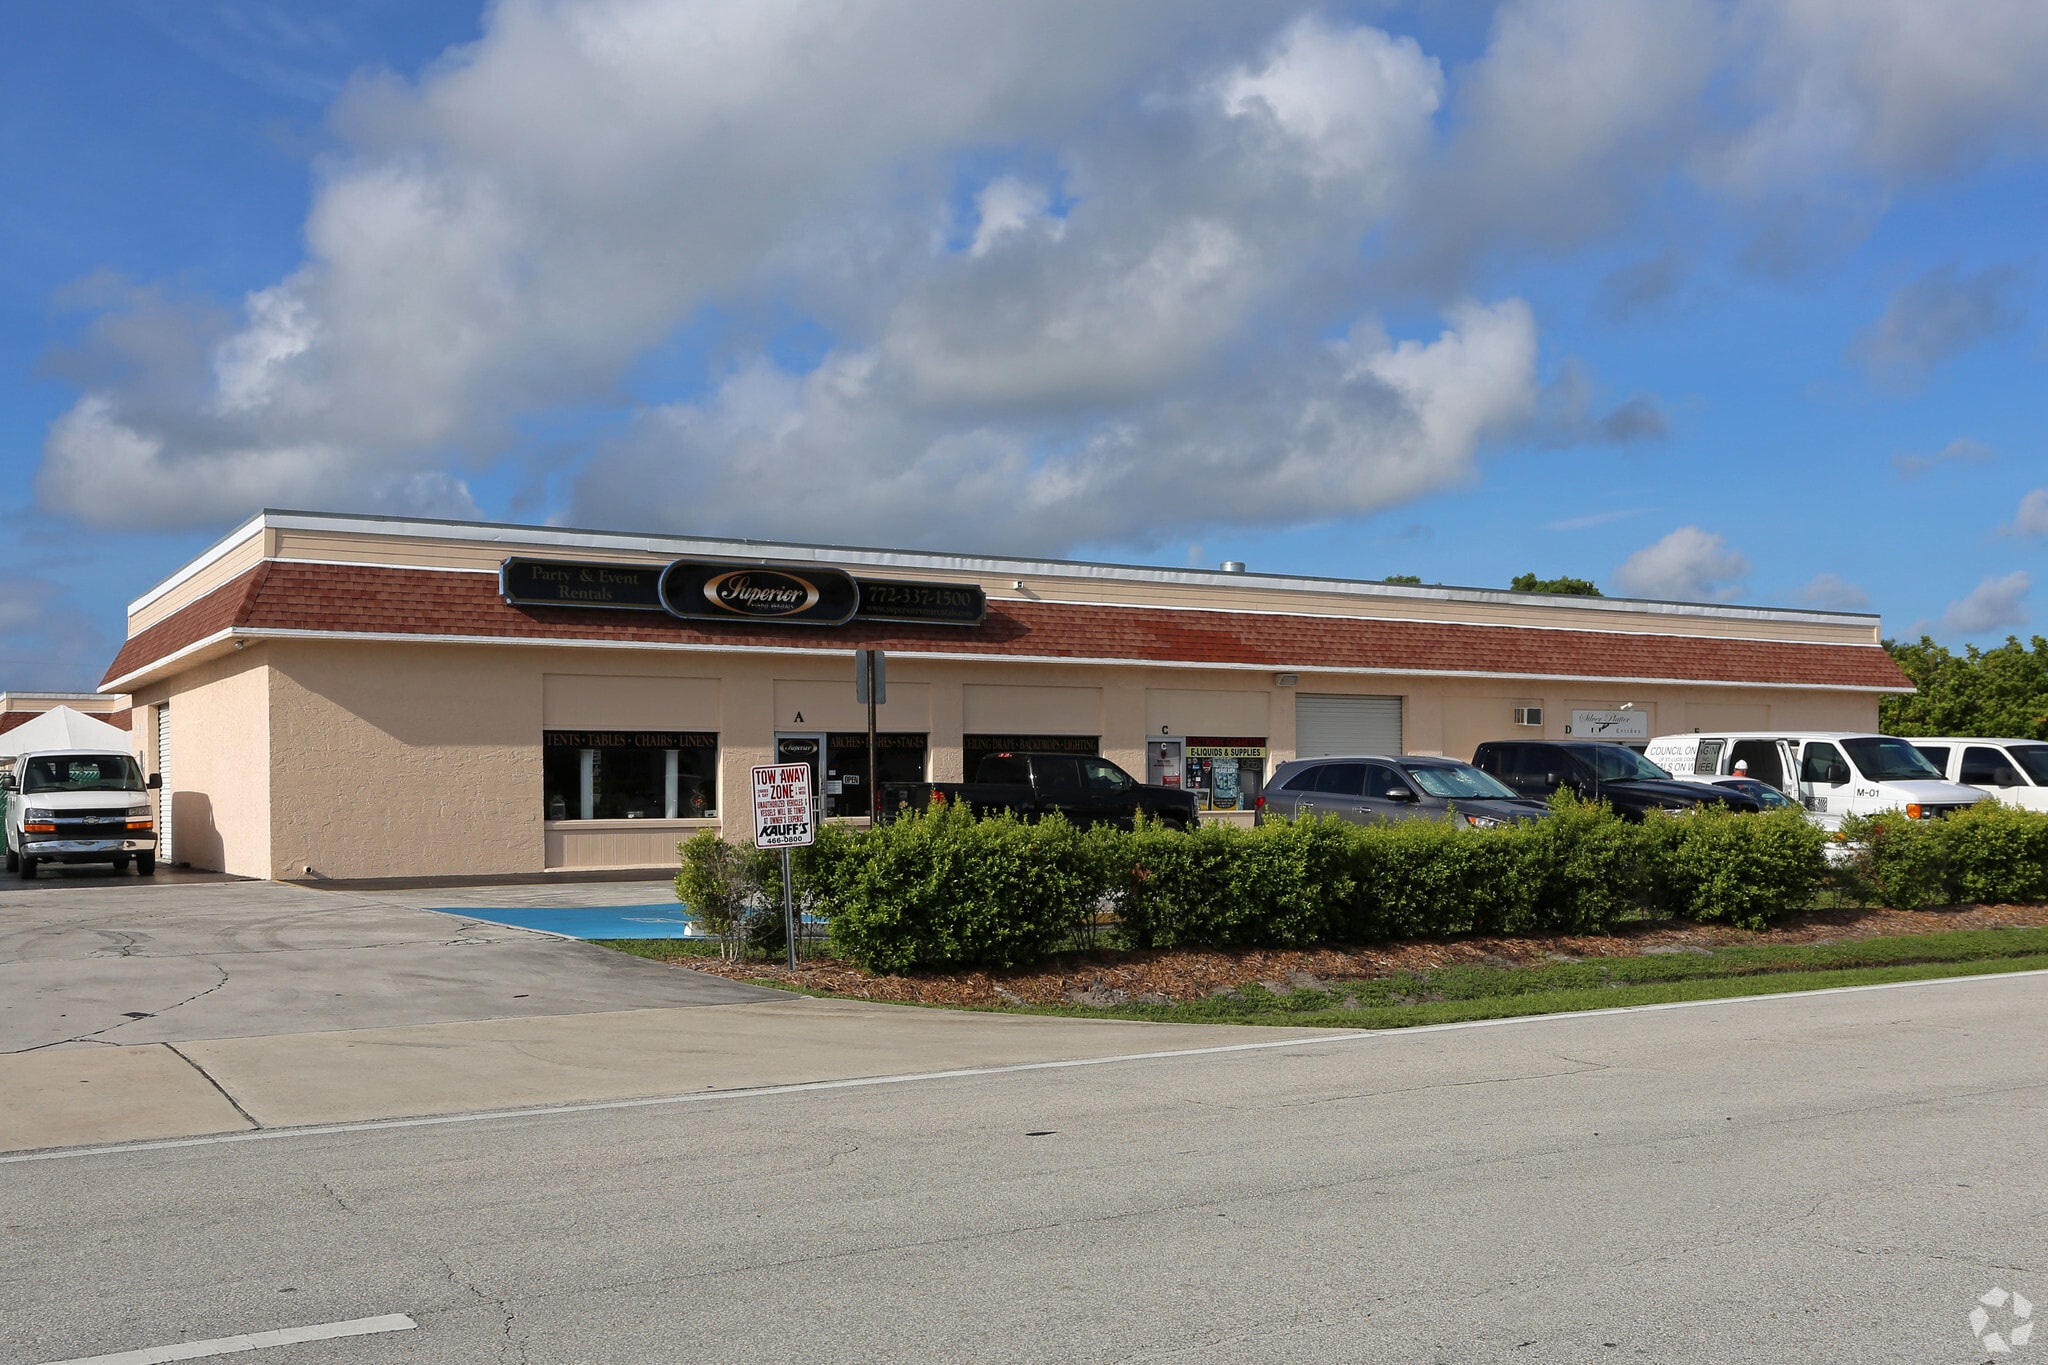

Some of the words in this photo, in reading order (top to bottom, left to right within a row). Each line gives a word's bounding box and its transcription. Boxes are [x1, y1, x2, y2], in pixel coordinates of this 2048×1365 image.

[532, 566, 571, 584] Party
[579, 568, 593, 582] &
[599, 569, 640, 585] Event
[559, 585, 613, 600] Rentals
[721, 575, 803, 606] Superior
[868, 586, 971, 606] 772-337-1500
[793, 711, 805, 723] A
[1161, 725, 1169, 735] C
[1565, 725, 1572, 735] D
[547, 733, 581, 747] TENTS
[587, 733, 625, 747] TABLES
[634, 734, 673, 748] CHAIRS
[679, 734, 715, 748] LINENS
[831, 735, 861, 748] ARCHES
[896, 736, 925, 748] STAGES
[1064, 738, 1097, 750] LIGHTING
[1160, 743, 1167, 751] C
[1190, 748, 1223, 756] E-LIQUIDS
[1224, 748, 1229, 756] &
[1230, 748, 1261, 756] SUPPLIES
[1650, 746, 1683, 756] COUNCIL
[1684, 746, 1697, 755] ON
[1674, 763, 1687, 771] ON
[755, 769, 776, 785] TOW
[780, 767, 806, 784] AWAY
[845, 775, 859, 784] OPEN
[770, 784, 794, 800] ZONE
[1856, 788, 1880, 798] M-01
[787, 807, 792, 815] BE
[759, 822, 809, 837] KAUFF'S
[767, 836, 803, 844] 466-0800
